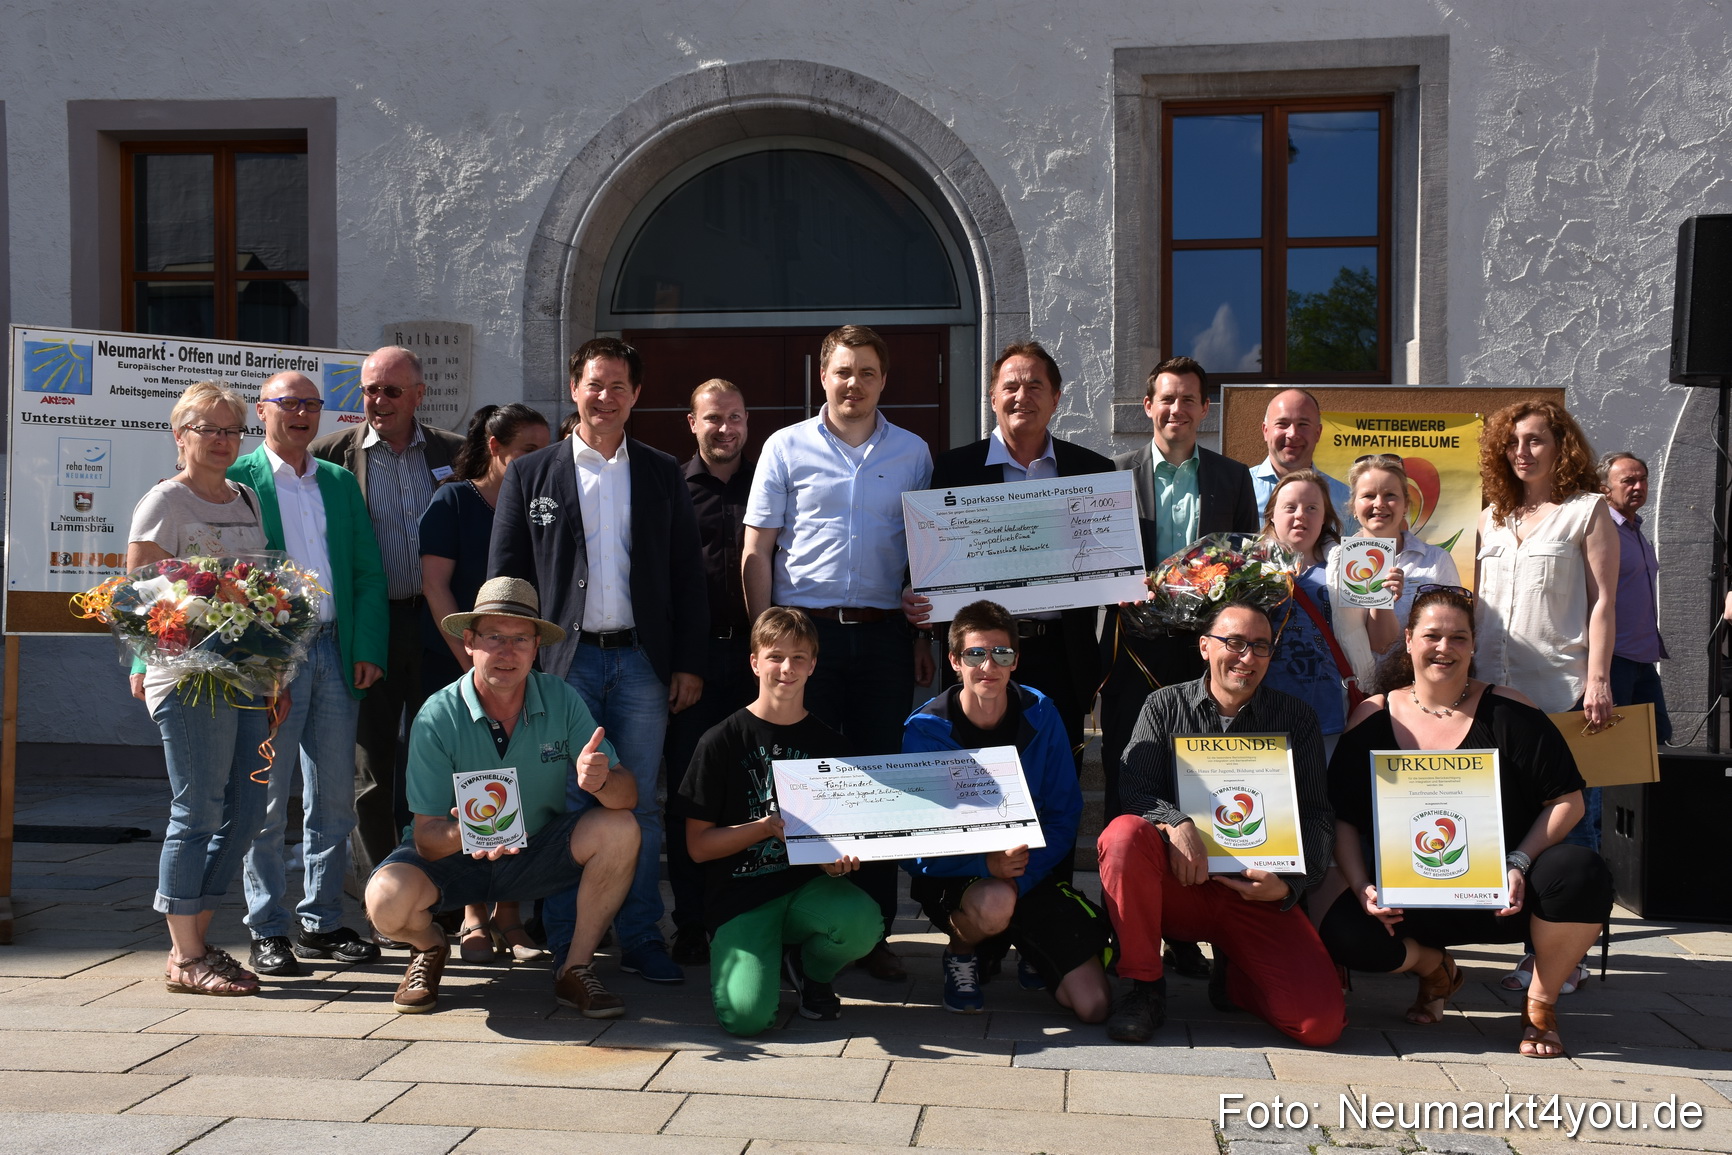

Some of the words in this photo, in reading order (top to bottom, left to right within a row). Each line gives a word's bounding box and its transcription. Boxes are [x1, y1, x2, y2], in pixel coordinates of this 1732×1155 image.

[395, 332, 459, 346] Rathaus
[98, 340, 166, 361] Neumarkt
[178, 346, 213, 364] Offen
[218, 351, 241, 366] und
[246, 351, 319, 372] Barrierefrei
[118, 361, 176, 372] Europäischer
[178, 365, 223, 377] Protesttag
[225, 369, 238, 377] zur
[444, 372, 458, 380] 1945
[143, 376, 159, 384] von
[110, 385, 185, 399] Arbeitsgemeinsc
[21, 411, 116, 427] Unterstützer
[1356, 418, 1446, 432] WETTBEWERB
[1333, 434, 1460, 448] SYMPATHIEBLUME
[66, 461, 83, 472] reha
[84, 462, 103, 472] team
[65, 472, 103, 480] NEUMARKT
[960, 495, 1005, 507] Sparkasse
[1008, 485, 1094, 501] Neumarkt-Parsberg
[59, 514, 107, 523] Neumarkter
[1070, 515, 1113, 525] Neumarkt
[50, 521, 115, 533] Lammsbräu
[1345, 540, 1392, 554] SYMPATHIEBLUME
[1186, 738, 1277, 752] URKUNDE
[835, 764, 883, 774] Sparkasse
[886, 757, 976, 769] Neumarkt-Parsberg
[1387, 756, 1484, 772] URKUNDE
[460, 774, 514, 790] SYMPATHIEBLUME
[955, 779, 996, 790] Neumarkt
[1212, 786, 1260, 798] SYMPATHIEBLUME
[1412, 809, 1463, 822] SYMPATHIEBLUME
[1432, 867, 1465, 877] BEHINDERUNG
